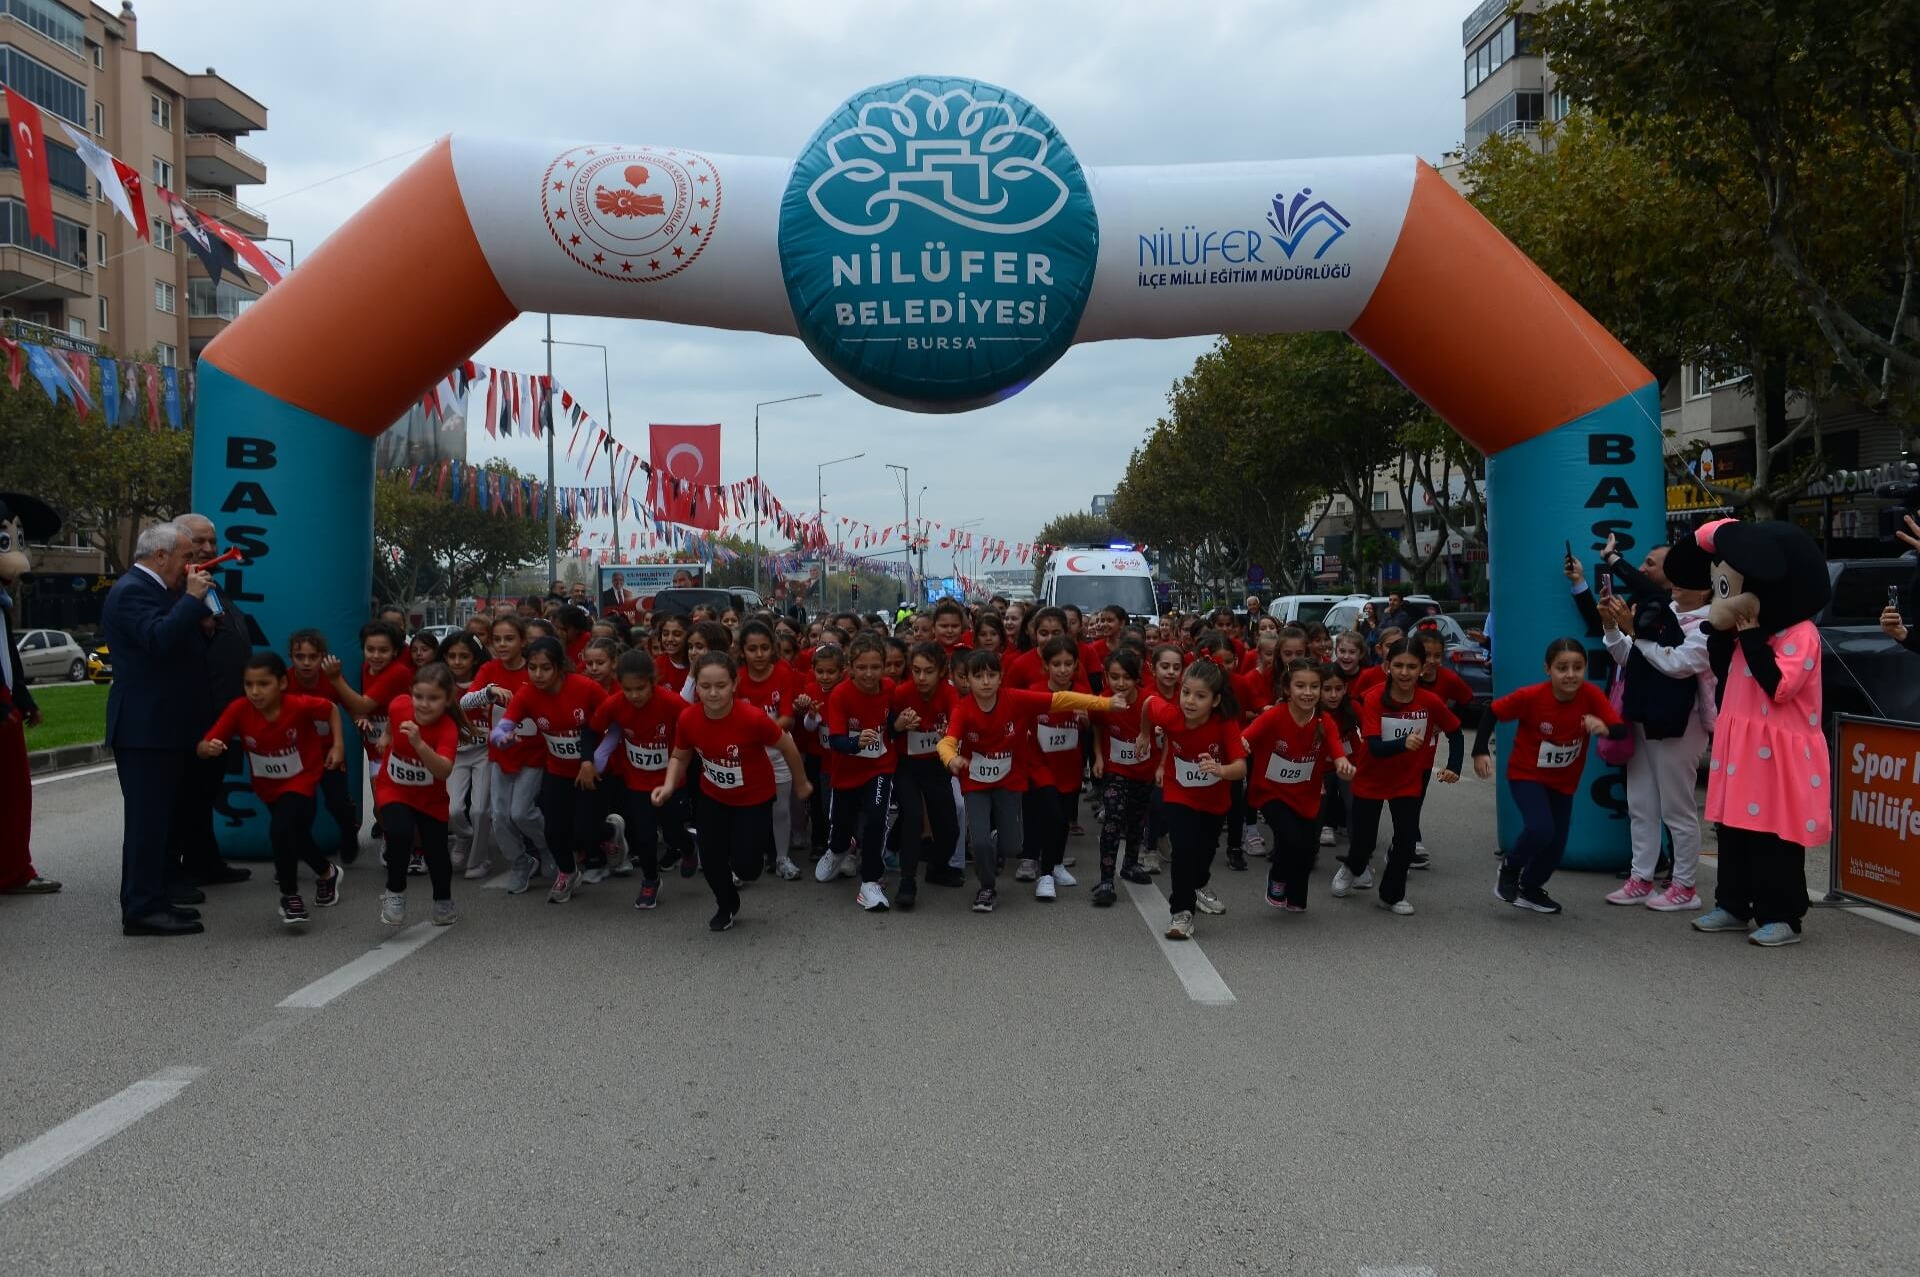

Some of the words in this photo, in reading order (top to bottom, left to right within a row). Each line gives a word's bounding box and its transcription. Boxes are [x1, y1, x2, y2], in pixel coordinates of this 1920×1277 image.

[1139, 226, 1265, 267] NİLÜFER
[832, 242, 1054, 287] NİLÜFER
[1138, 270, 1167, 289] İLÇE
[1170, 269, 1207, 286] MİLLİ
[1210, 267, 1258, 284] EĞİTİM
[1261, 263, 1351, 282] MÜDÜRLÜĞÜ
[835, 291, 1047, 326] BELEDİYESİ
[907, 337, 978, 350] BURSA
[1049, 736, 1066, 746] 123
[629, 750, 662, 767] 1570
[1851, 742, 1907, 784] Spor
[265, 763, 288, 775] 001
[390, 764, 426, 783] 1599
[979, 766, 999, 776] 070
[1186, 770, 1209, 781] 042
[1279, 768, 1302, 779] 029
